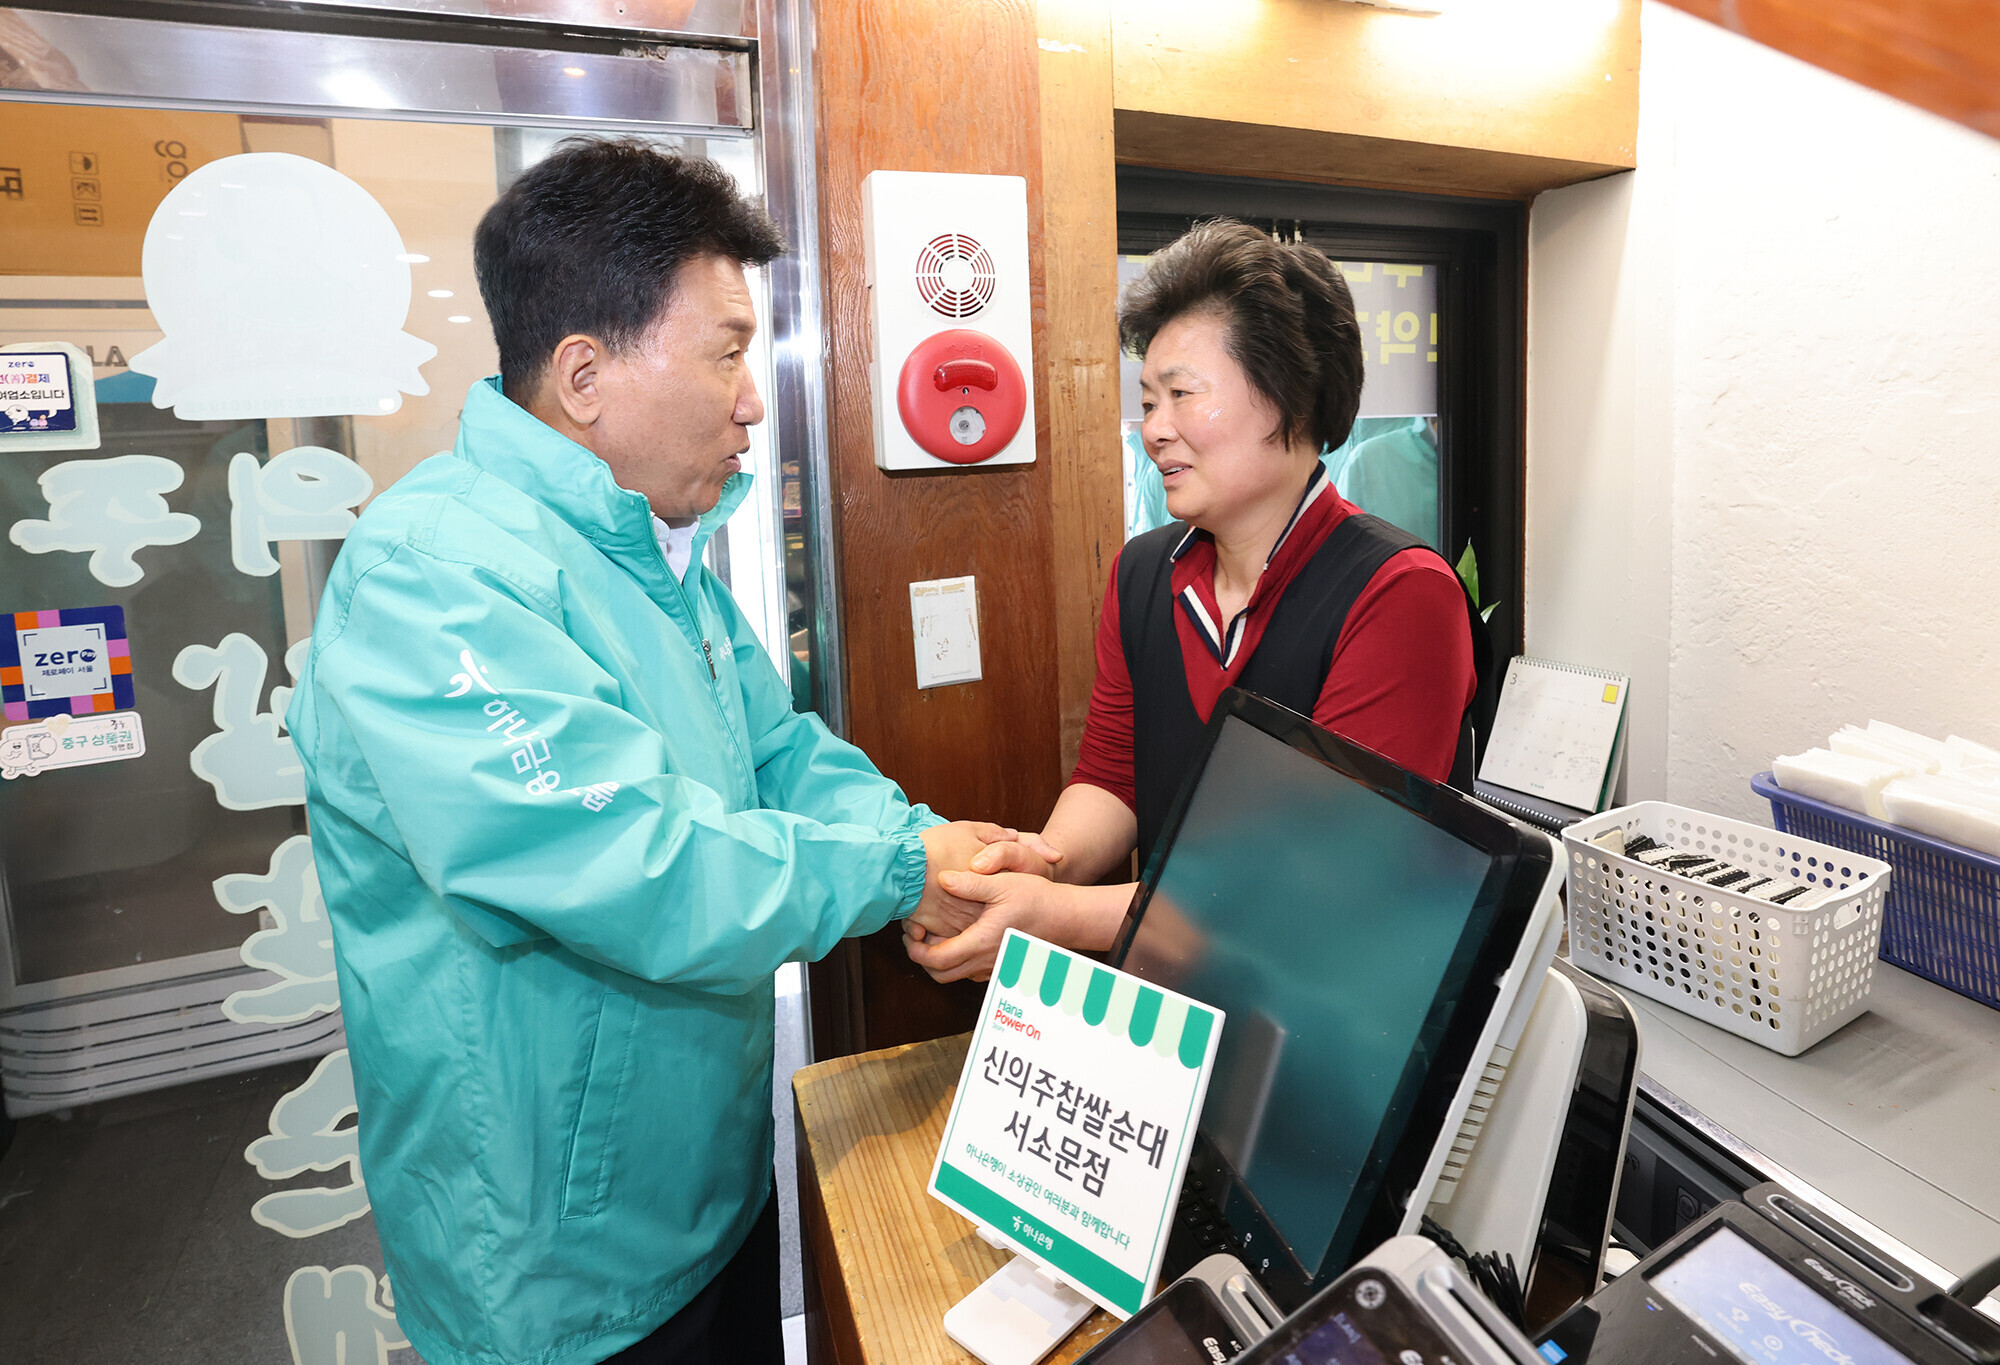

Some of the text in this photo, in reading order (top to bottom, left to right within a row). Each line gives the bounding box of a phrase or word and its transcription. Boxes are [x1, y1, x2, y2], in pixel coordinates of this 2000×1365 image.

[34, 649, 97, 667] zero
[1509, 673, 1518, 685] 3
[62, 730, 133, 750] 중구 상품권
[998, 998, 1023, 1018] Hana
[994, 1009, 1041, 1041] Power On
[984, 1046, 1169, 1170] 신의주찹쌀순대
[1004, 1110, 1111, 1197] 서소문점
[965, 1143, 1131, 1251] 하나은행이 소상공인 여러분과 함께합니다
[1022, 1224, 1054, 1251] 하나은행
